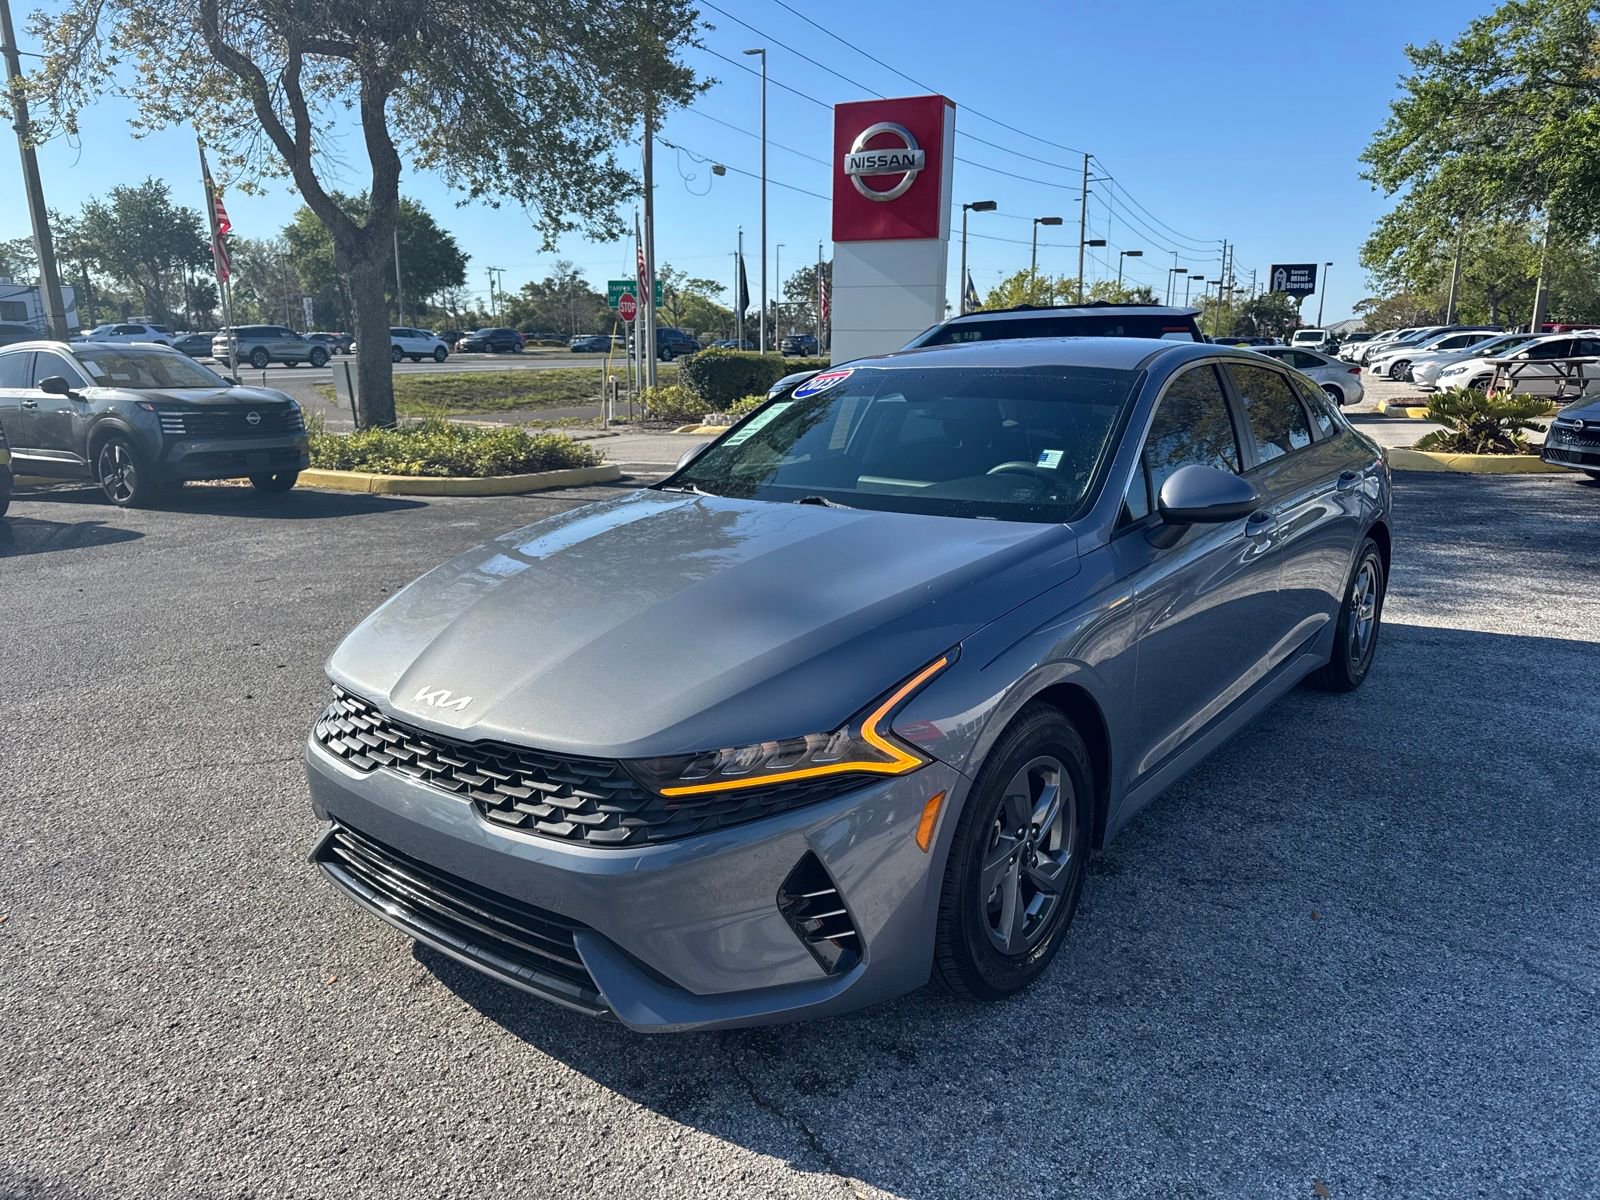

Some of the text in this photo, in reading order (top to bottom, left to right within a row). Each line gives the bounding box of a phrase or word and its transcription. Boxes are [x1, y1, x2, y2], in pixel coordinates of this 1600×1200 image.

[850, 154, 915, 169] NISSAN
[620, 302, 636, 312] STOP
[411, 685, 474, 712] KIA
